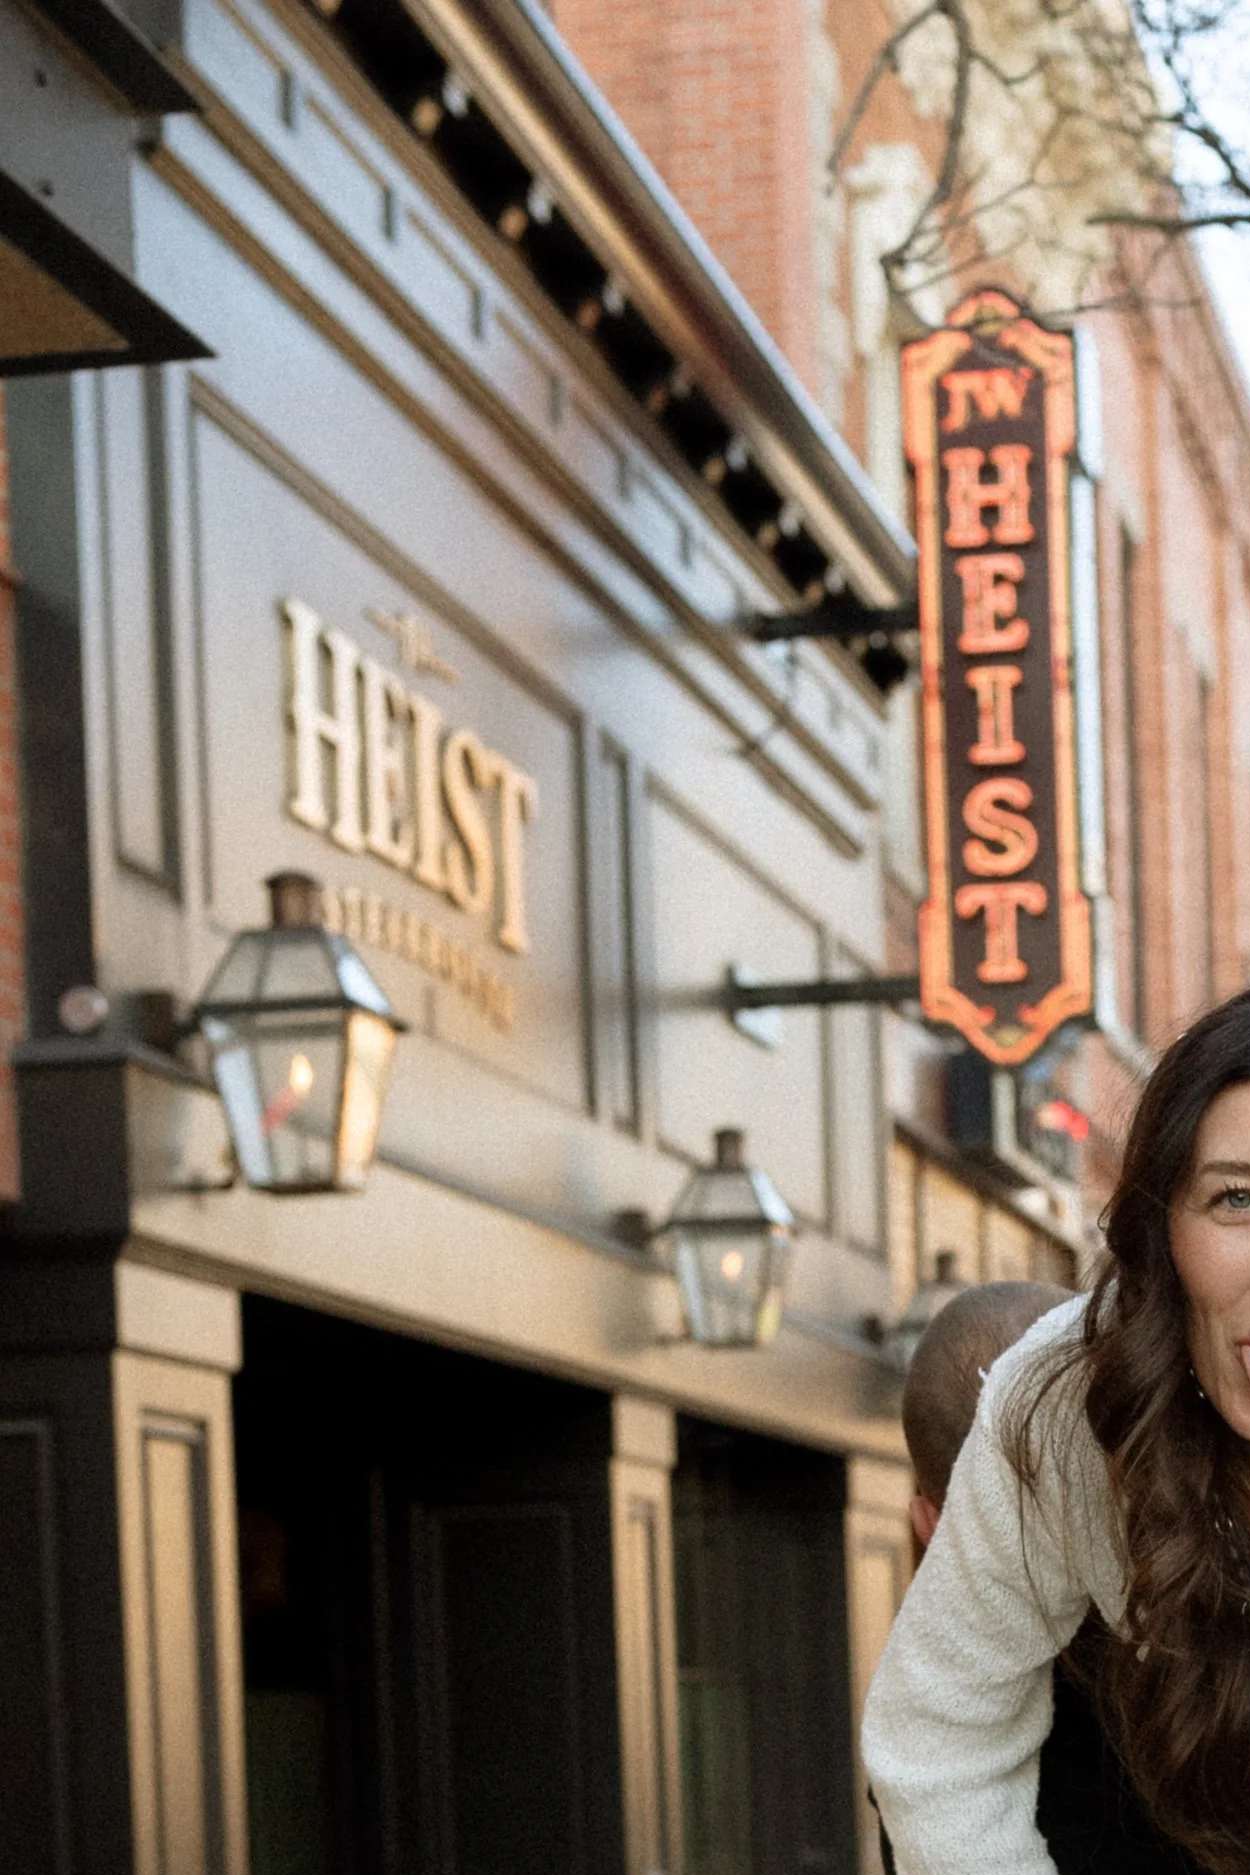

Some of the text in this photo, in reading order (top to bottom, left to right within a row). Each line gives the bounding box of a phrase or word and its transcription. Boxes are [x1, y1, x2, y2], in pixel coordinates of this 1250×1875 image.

[940, 366, 1034, 433] JW
[282, 598, 538, 955] HEIST
[942, 444, 1047, 985] HEIST
